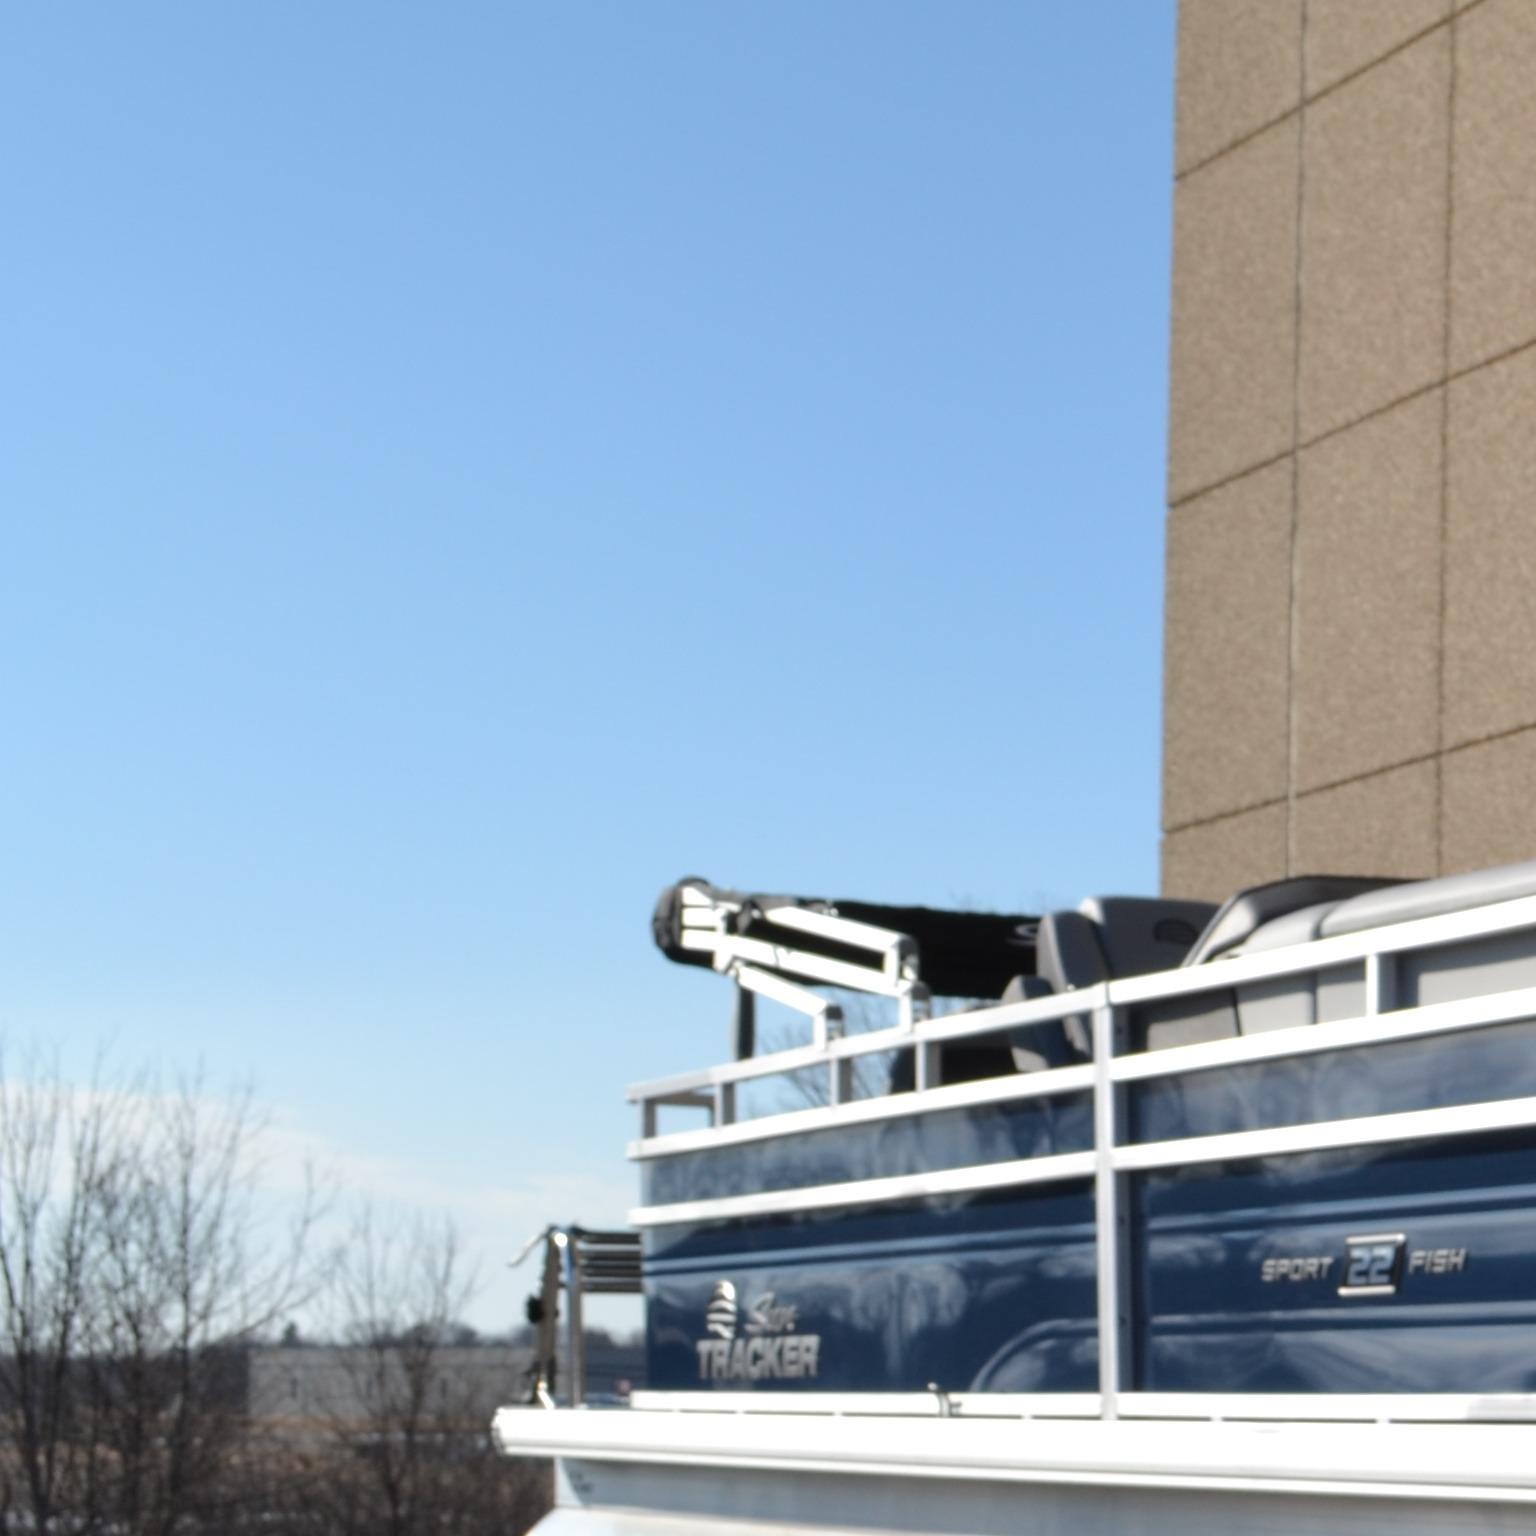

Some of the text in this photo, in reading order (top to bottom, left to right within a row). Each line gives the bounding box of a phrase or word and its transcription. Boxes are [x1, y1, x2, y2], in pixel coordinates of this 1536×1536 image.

[1261, 1247, 1467, 1284] SPORT 22 FISH
[696, 1334, 820, 1380] TRACKER
